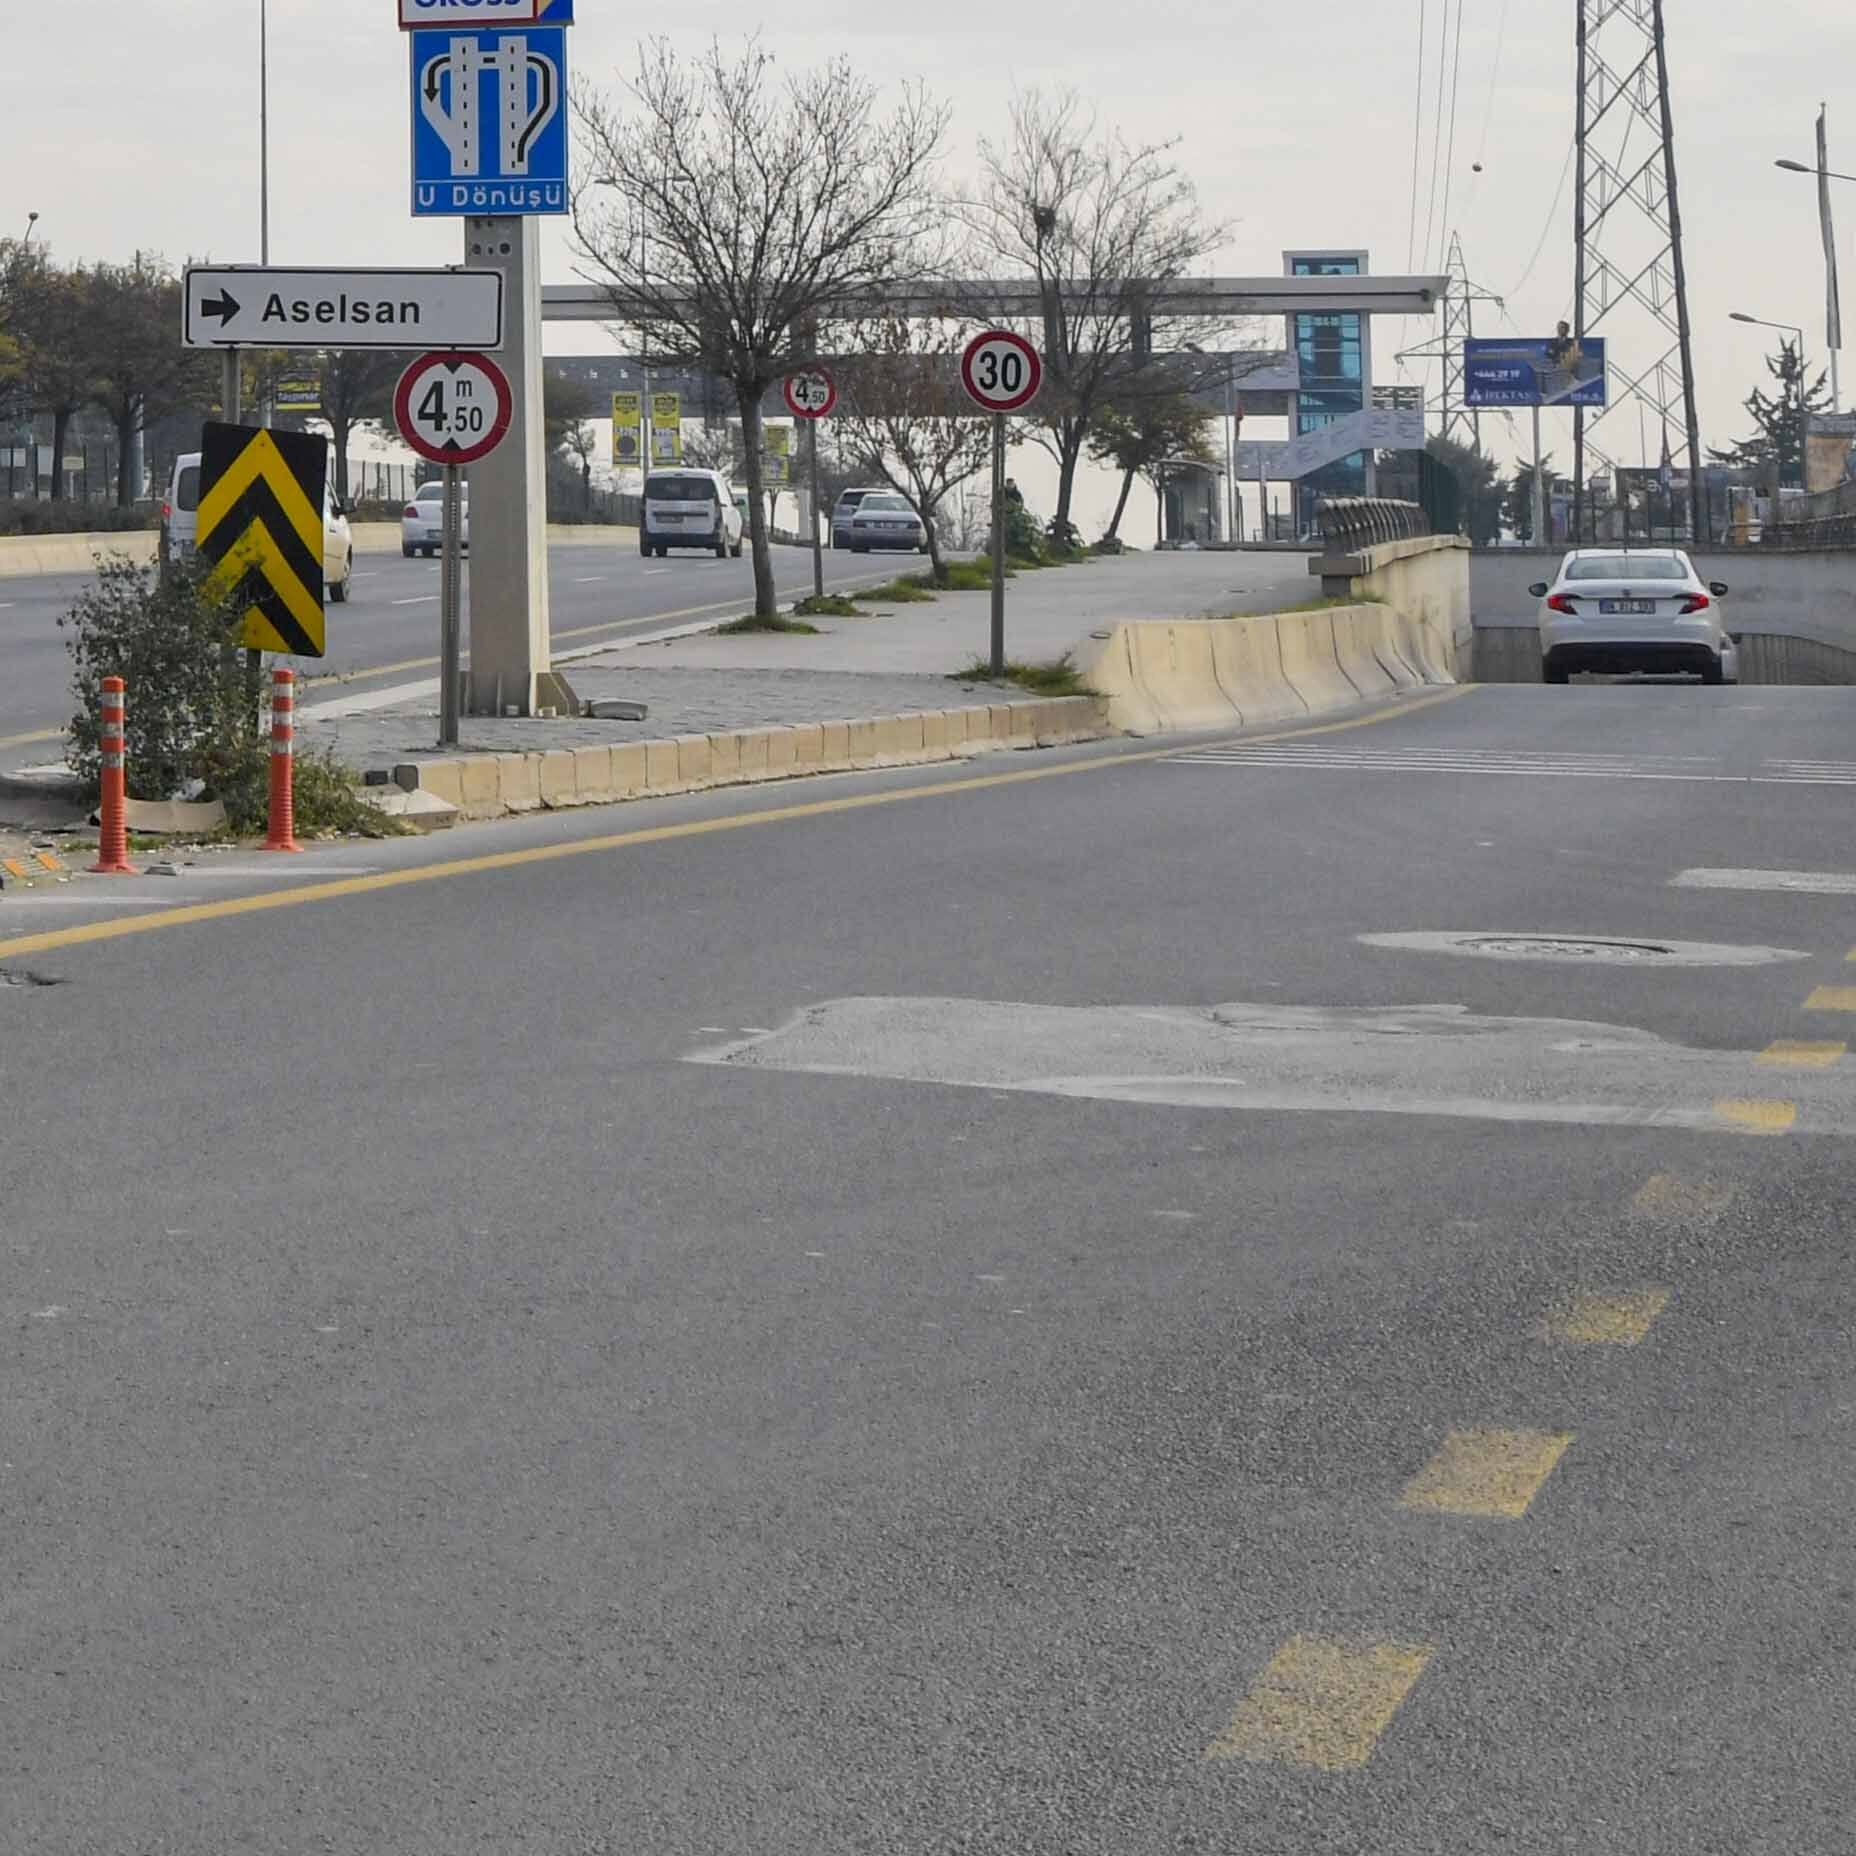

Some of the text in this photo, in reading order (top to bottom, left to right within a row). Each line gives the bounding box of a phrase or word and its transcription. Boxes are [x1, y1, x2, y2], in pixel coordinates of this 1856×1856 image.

[419, 185, 561, 208] U Dönüşü
[262, 294, 420, 324] Aselsan
[979, 351, 1022, 393] 30
